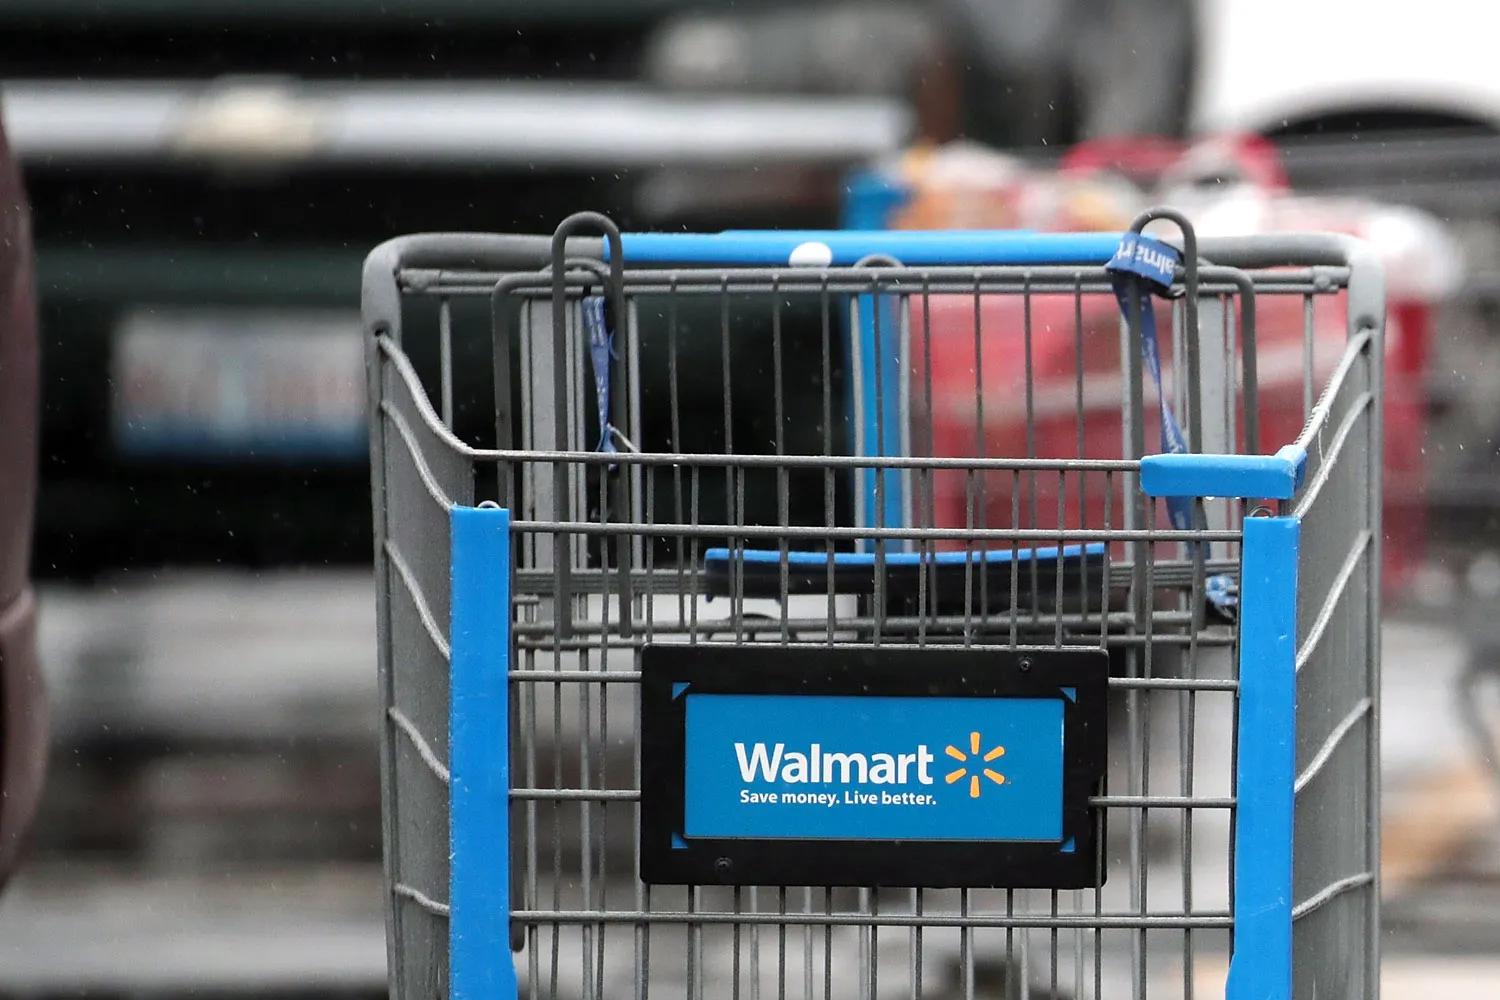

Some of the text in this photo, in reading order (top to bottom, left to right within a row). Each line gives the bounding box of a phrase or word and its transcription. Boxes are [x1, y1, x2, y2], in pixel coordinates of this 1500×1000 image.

[1116, 239, 1177, 275] almart
[735, 743, 934, 785] Walmart
[740, 789, 937, 808] Save money. Live better.
